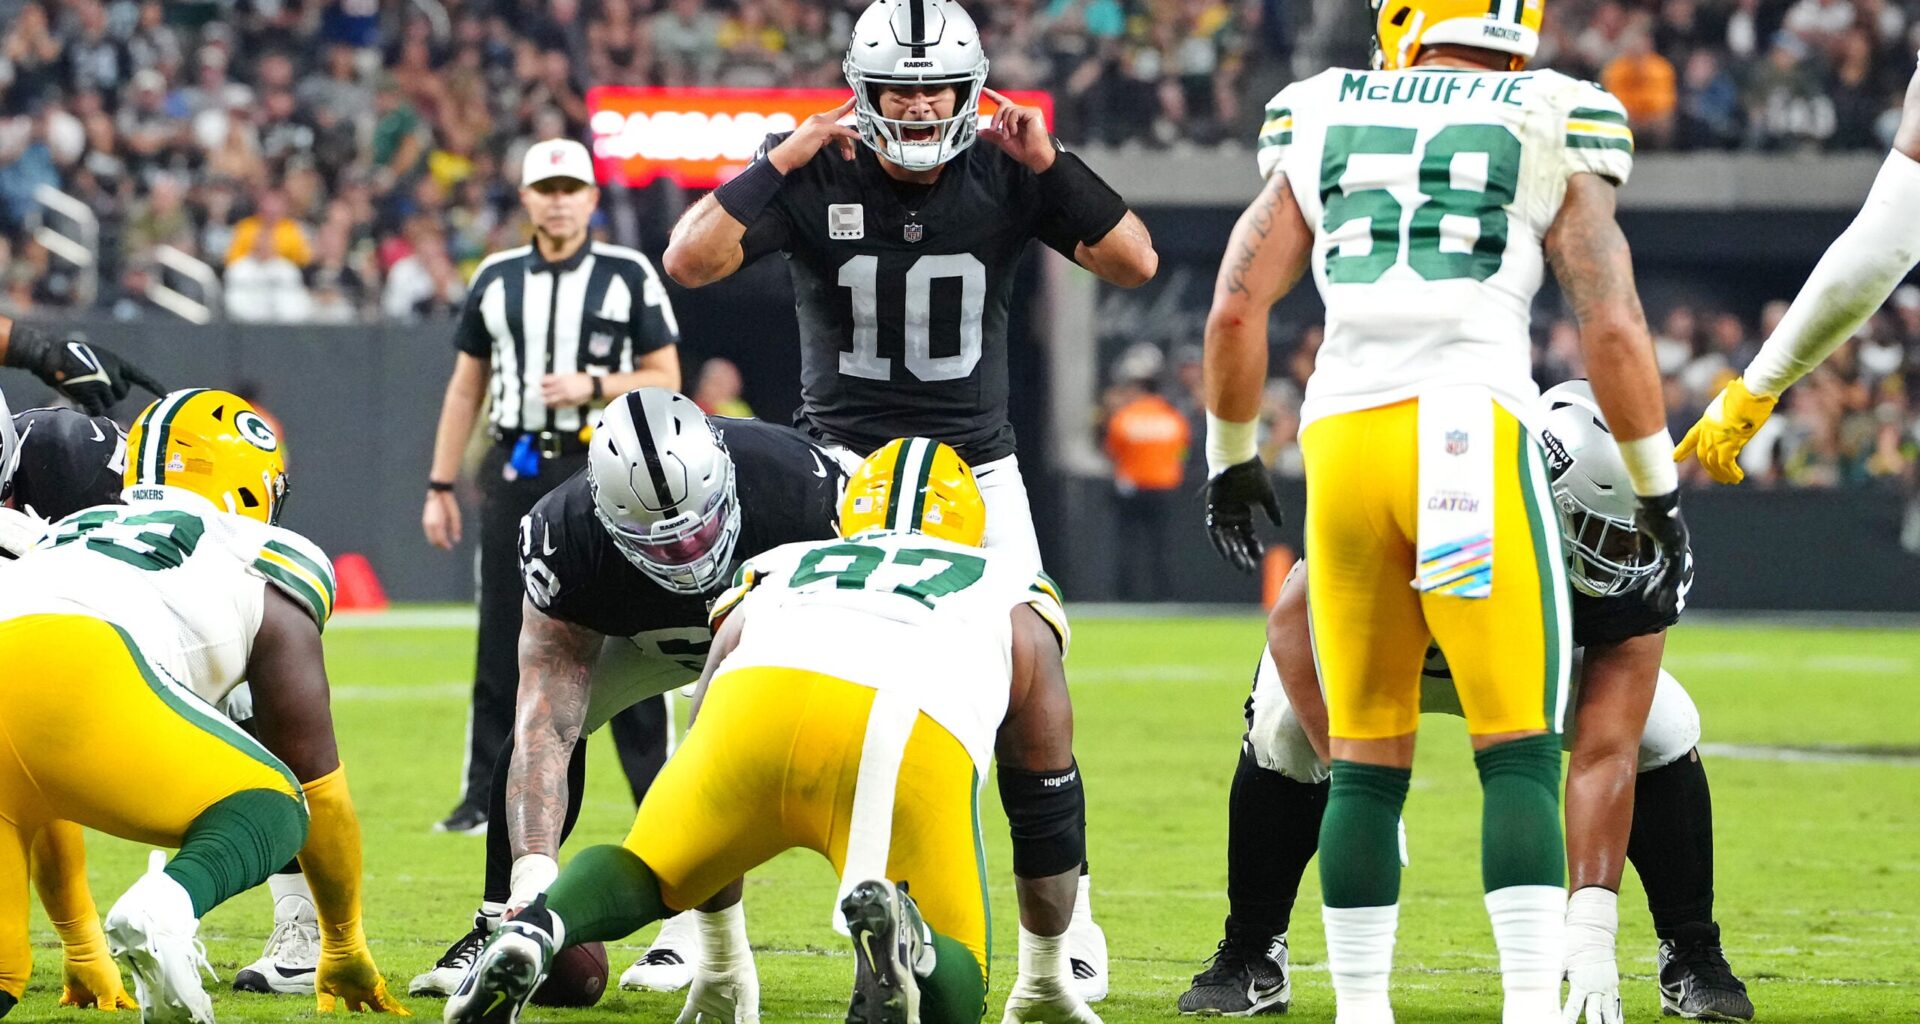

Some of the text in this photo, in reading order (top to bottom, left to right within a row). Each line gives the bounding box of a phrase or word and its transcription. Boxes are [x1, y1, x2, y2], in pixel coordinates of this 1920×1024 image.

[1320, 124, 1522, 284] 58
[838, 252, 986, 382] 10
[1543, 431, 1570, 463] RAIDERS
[132, 489, 164, 501] PACKERS
[1427, 496, 1479, 512] CATCH
[659, 518, 690, 531] RAIDERS
[788, 543, 987, 610] 97
